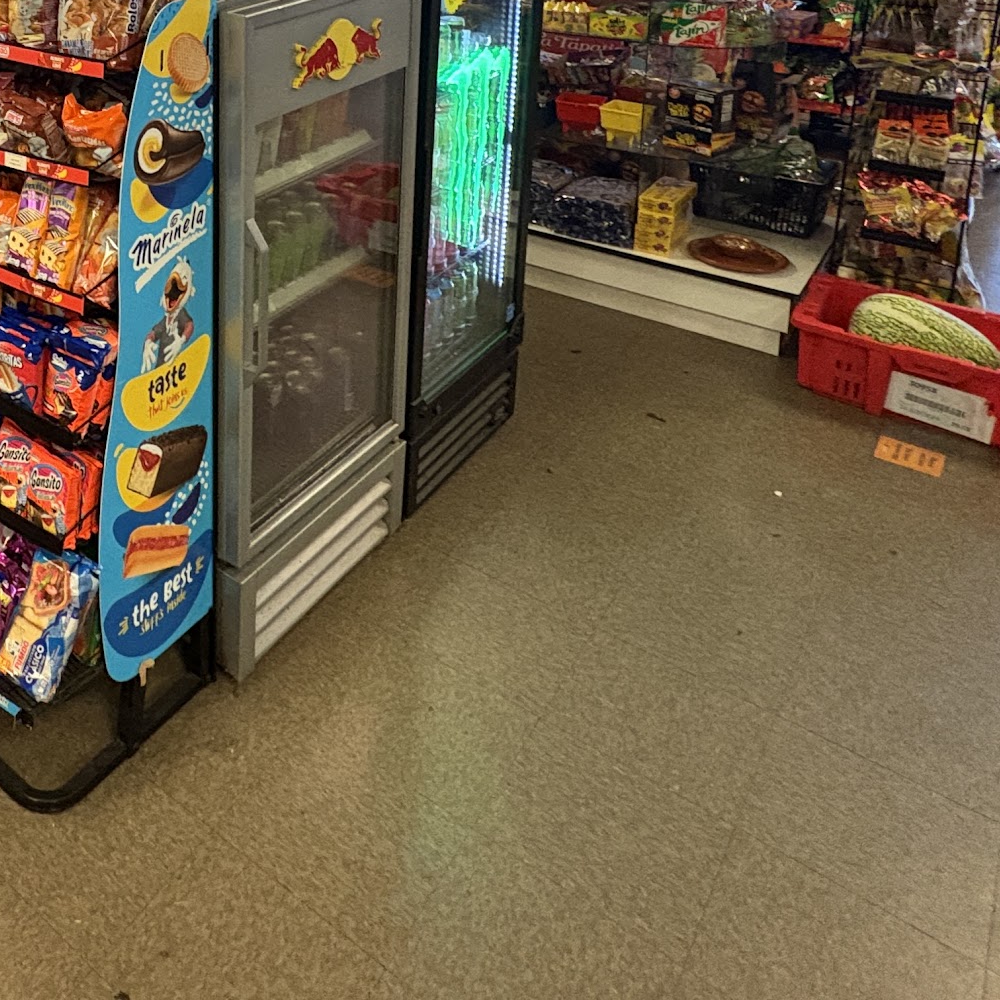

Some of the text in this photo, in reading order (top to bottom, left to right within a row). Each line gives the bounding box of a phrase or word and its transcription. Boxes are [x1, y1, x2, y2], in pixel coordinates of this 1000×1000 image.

[132, 207, 205, 267] Marinela
[148, 361, 187, 403] taste
[31, 468, 62, 490] Gansito
[132, 592, 159, 627] the
